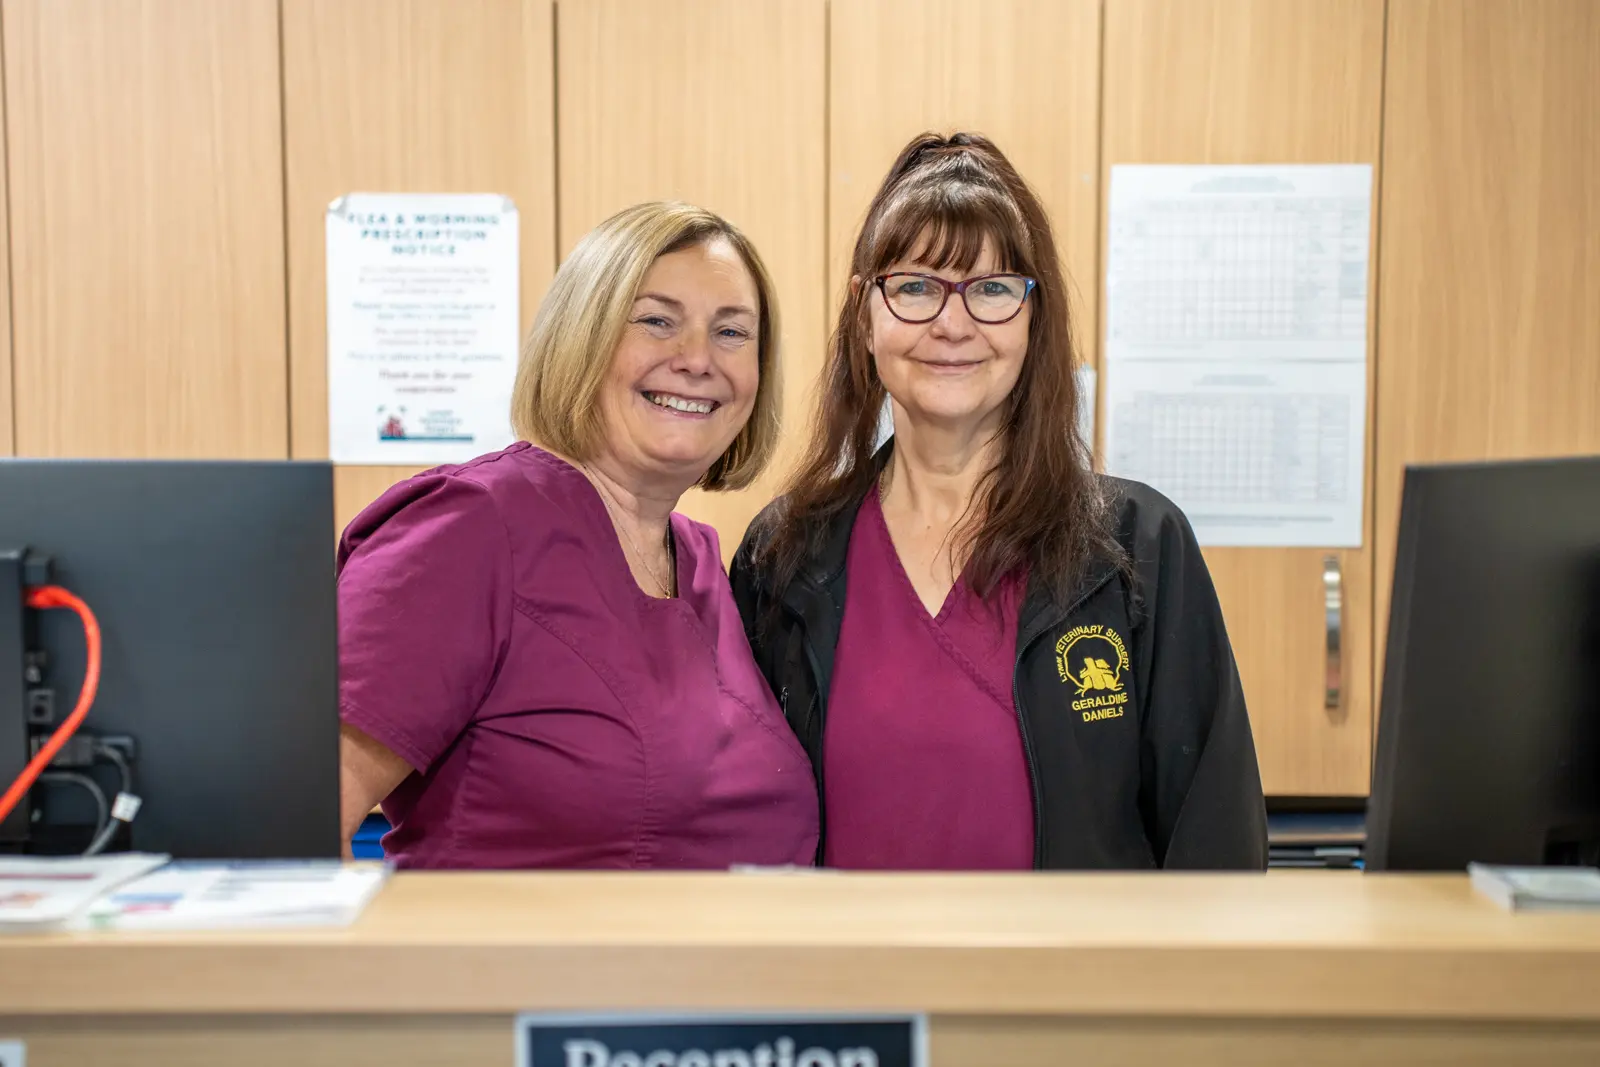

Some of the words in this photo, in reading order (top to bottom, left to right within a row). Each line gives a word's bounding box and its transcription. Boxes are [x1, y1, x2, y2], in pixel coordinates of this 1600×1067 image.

[347, 213, 388, 225] FLEA
[395, 213, 405, 225] &
[414, 213, 500, 225] WORMING
[361, 229, 487, 240] PRESCRIPTION
[392, 244, 456, 255] NOTICE
[1055, 625, 1104, 654] VETERINARY
[1105, 628, 1130, 671] SURGERY
[1071, 692, 1128, 711] GERALDINE
[1082, 706, 1124, 722] DANIELS
[563, 1036, 880, 1067] Reception
